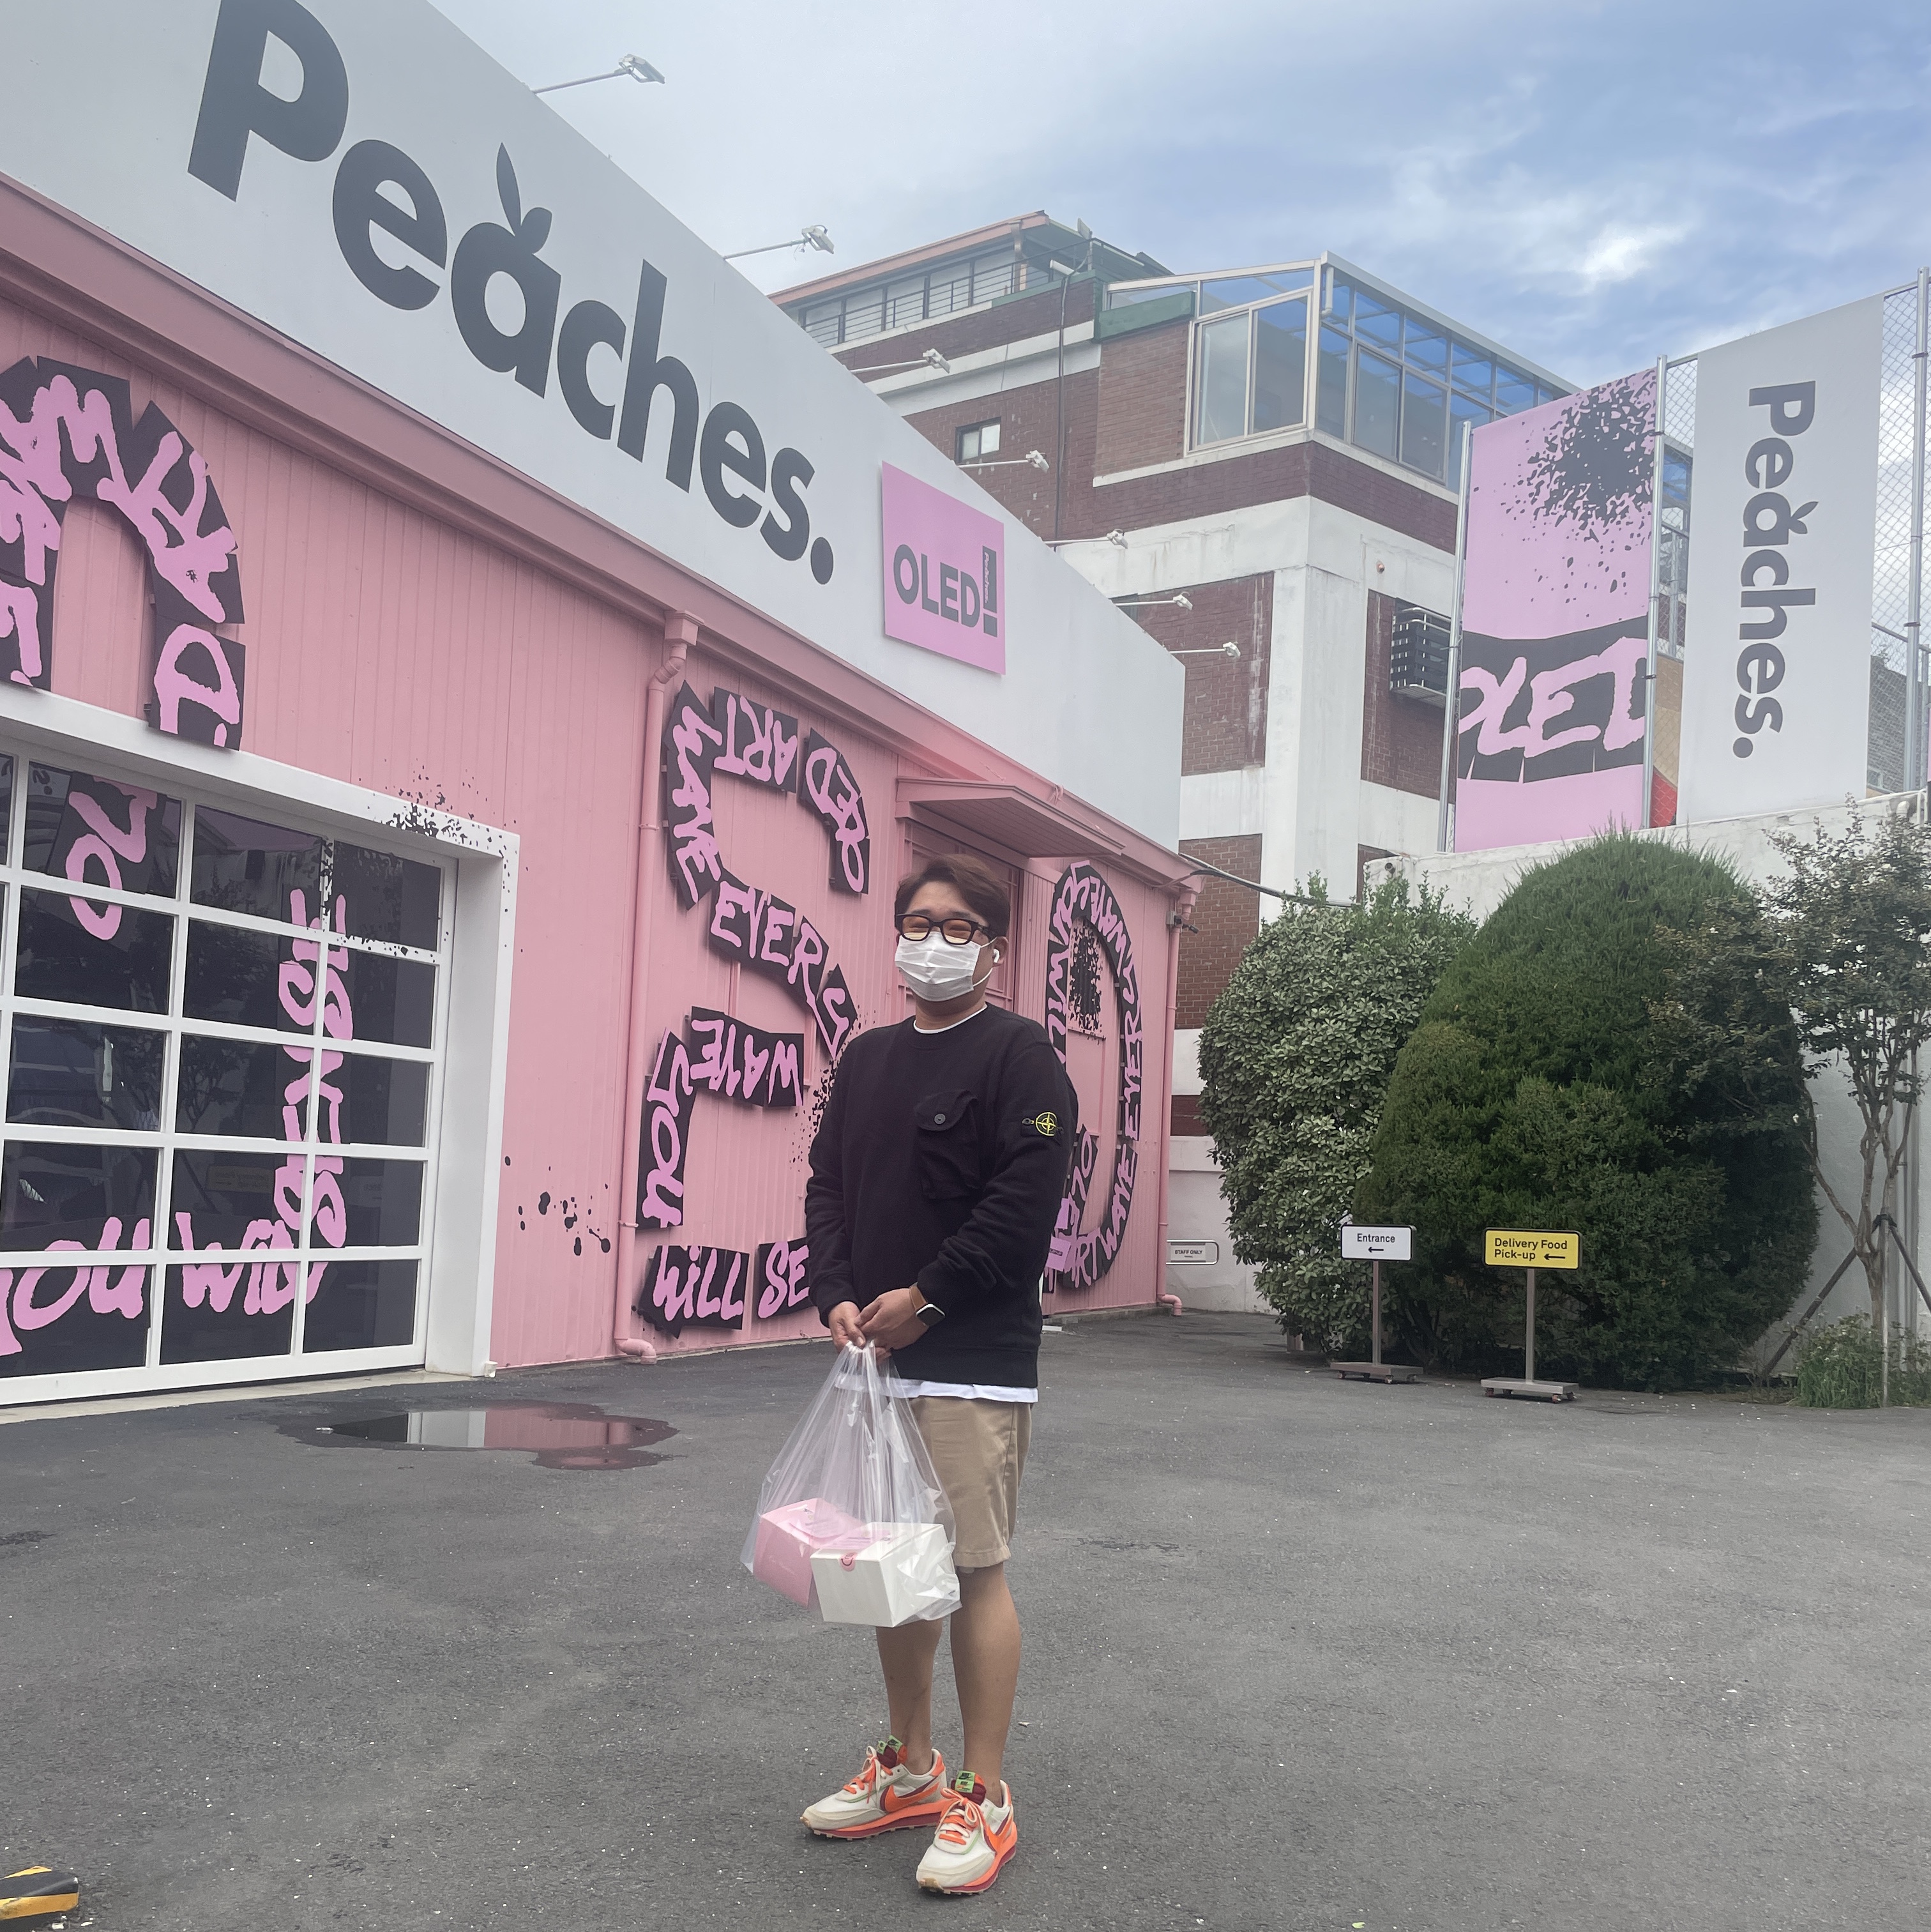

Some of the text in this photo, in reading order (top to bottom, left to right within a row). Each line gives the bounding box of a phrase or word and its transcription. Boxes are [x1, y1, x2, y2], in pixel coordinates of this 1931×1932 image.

[188, 0, 834, 585] Peaches.
[893, 544, 998, 638] OLED!
[1732, 381, 1819, 759] Peaches.
[713, 693, 798, 786] ART
[1357, 1233, 1395, 1243] Entrance
[1494, 1238, 1568, 1251] Delivery Food
[1494, 1249, 1536, 1261] Pick-up
